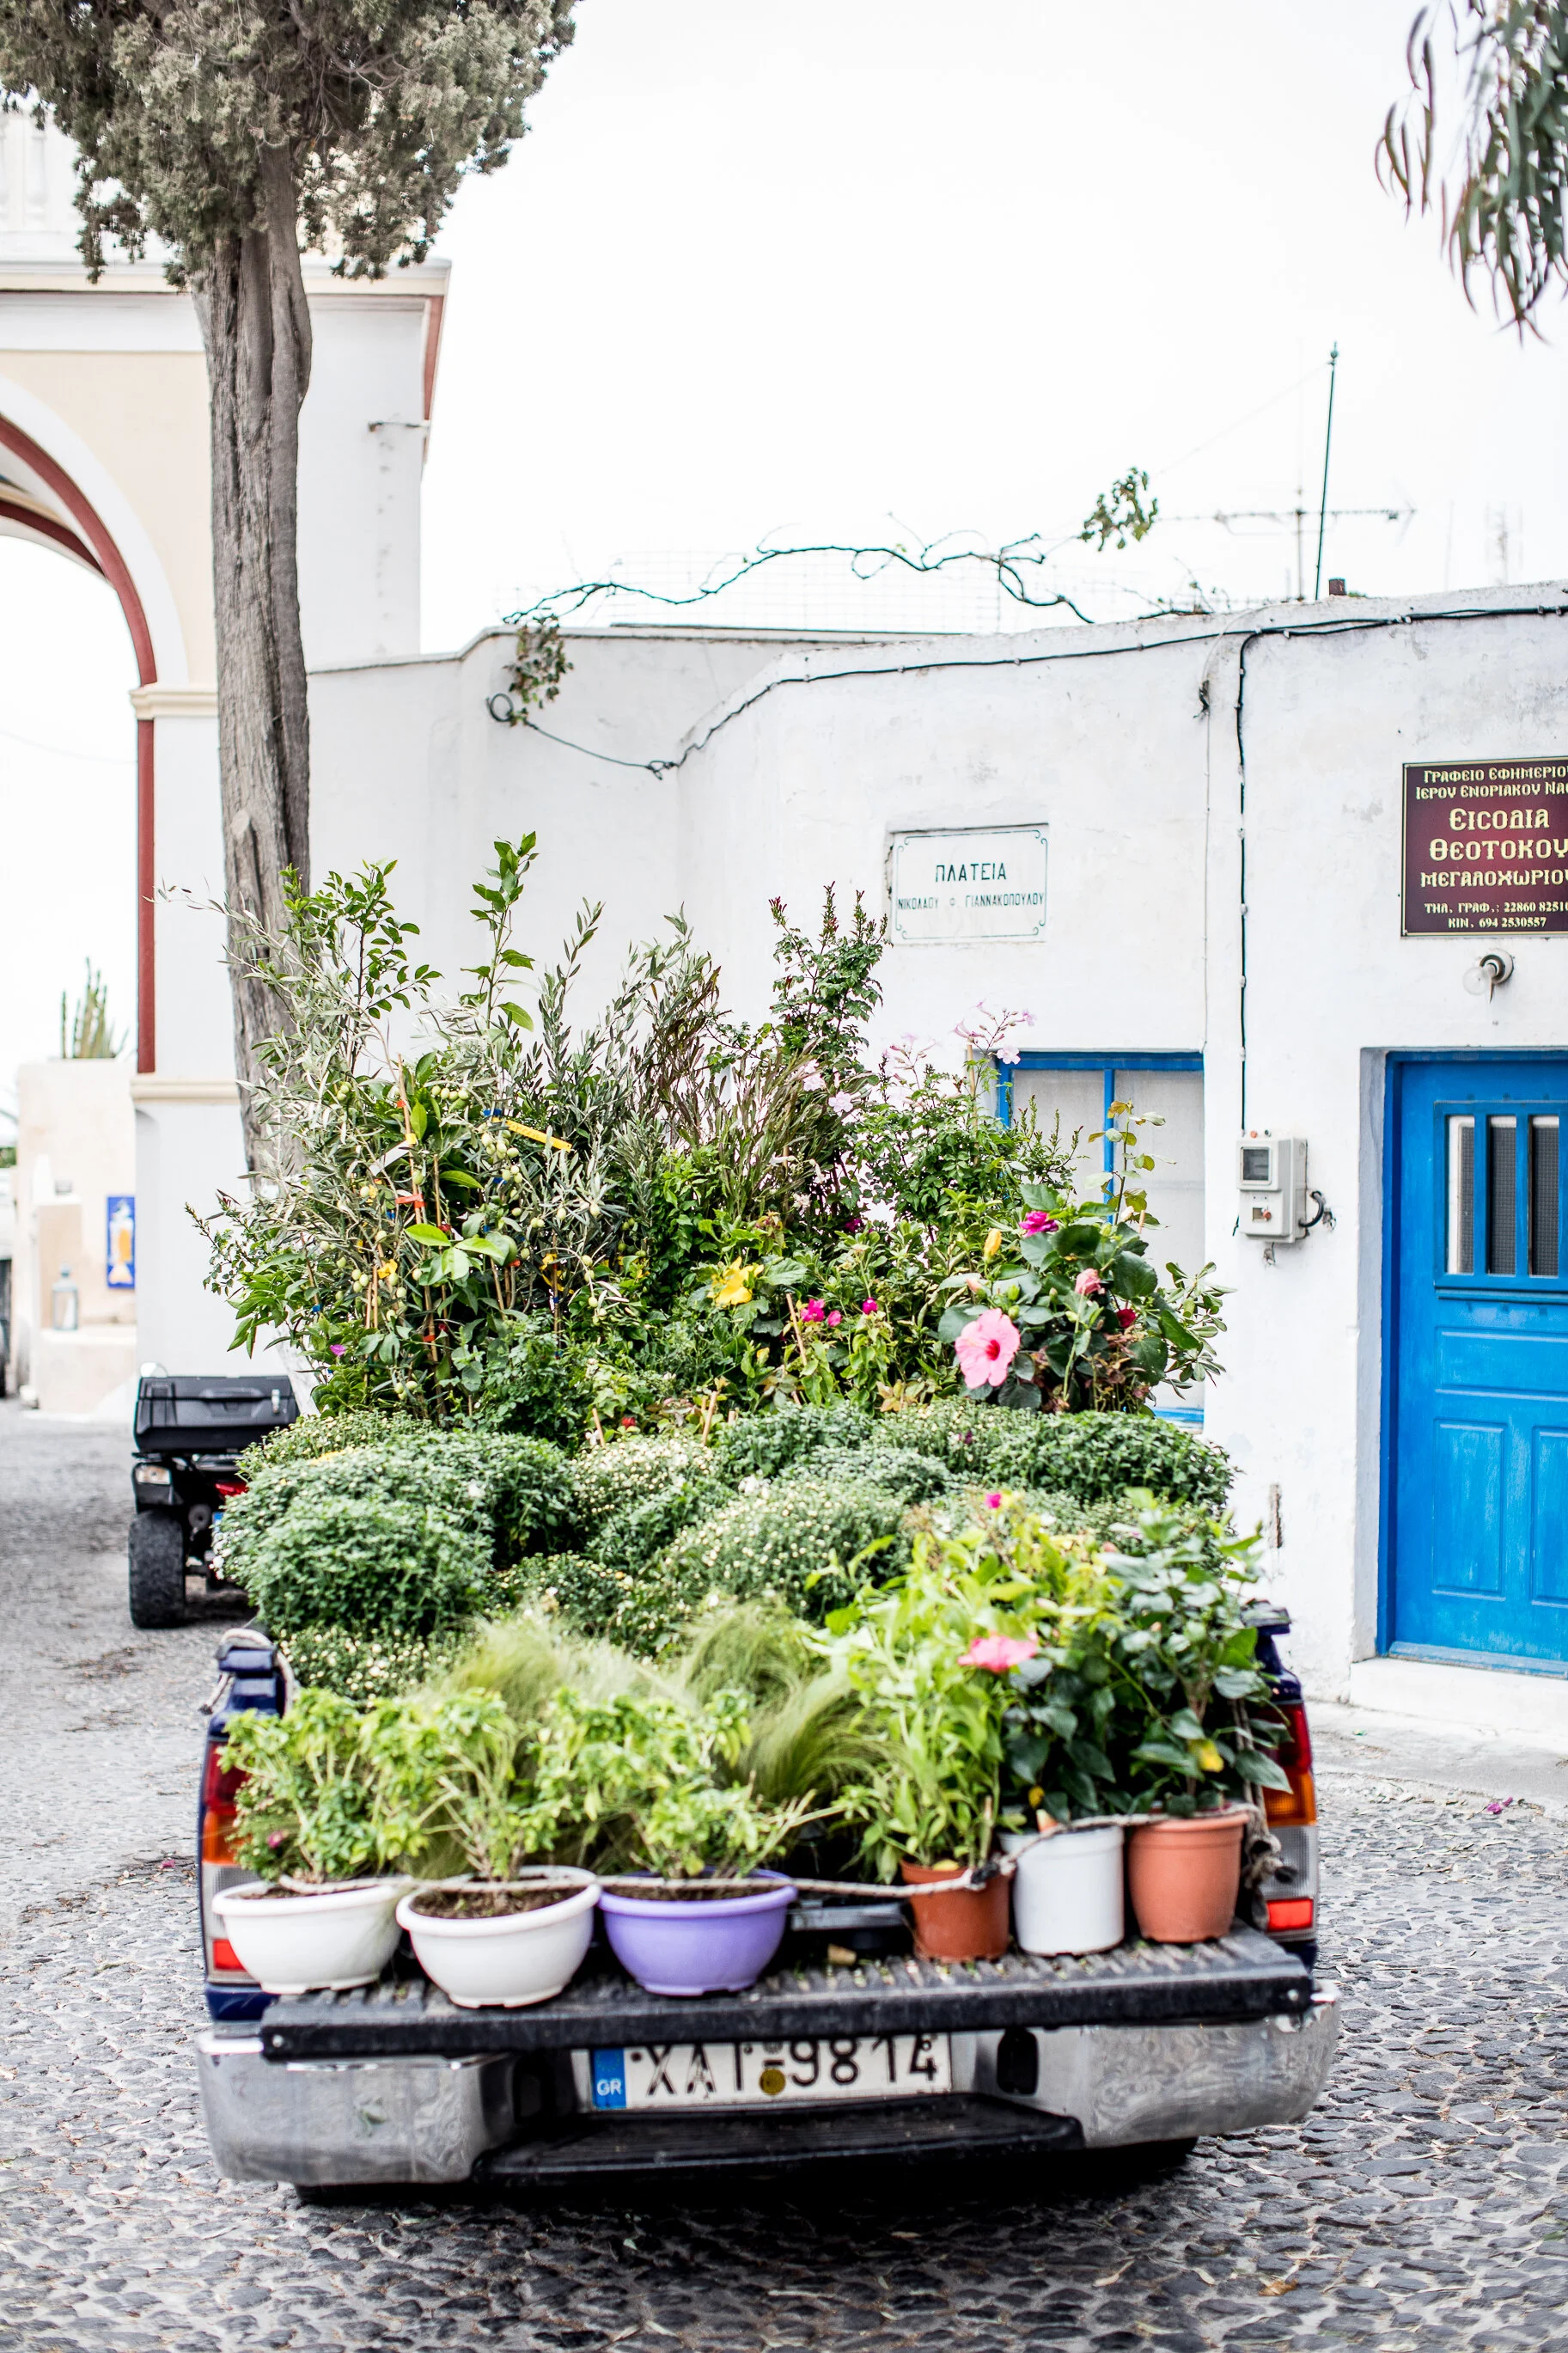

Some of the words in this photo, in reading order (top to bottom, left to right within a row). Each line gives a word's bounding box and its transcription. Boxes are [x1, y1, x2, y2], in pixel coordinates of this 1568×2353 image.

[1424, 769, 1485, 783] ΓΡΑΦΕΙΟ
[1489, 766, 1568, 781] ΕΦΗΜΕΡΙΟ
[1416, 786, 1456, 800] ΙΕΡΟΥ
[1461, 783, 1541, 798] ΕΝΟΡΙΑΚΟΥ
[1430, 838, 1568, 861] ΘΕΟΤΟΚΟΥ
[936, 863, 1007, 883] ΠΛΑΤΕΙΑ
[898, 897, 938, 910] ΝΙΚΟΛΑΟΥ
[966, 893, 1044, 908] ΓΙΑΝΝΑΚΟΠΟΥΛΟΥ
[1504, 902, 1536, 913] 22860
[1479, 917, 1498, 928] 694
[1502, 917, 1547, 927] 2530557
[597, 2079, 621, 2096] GR
